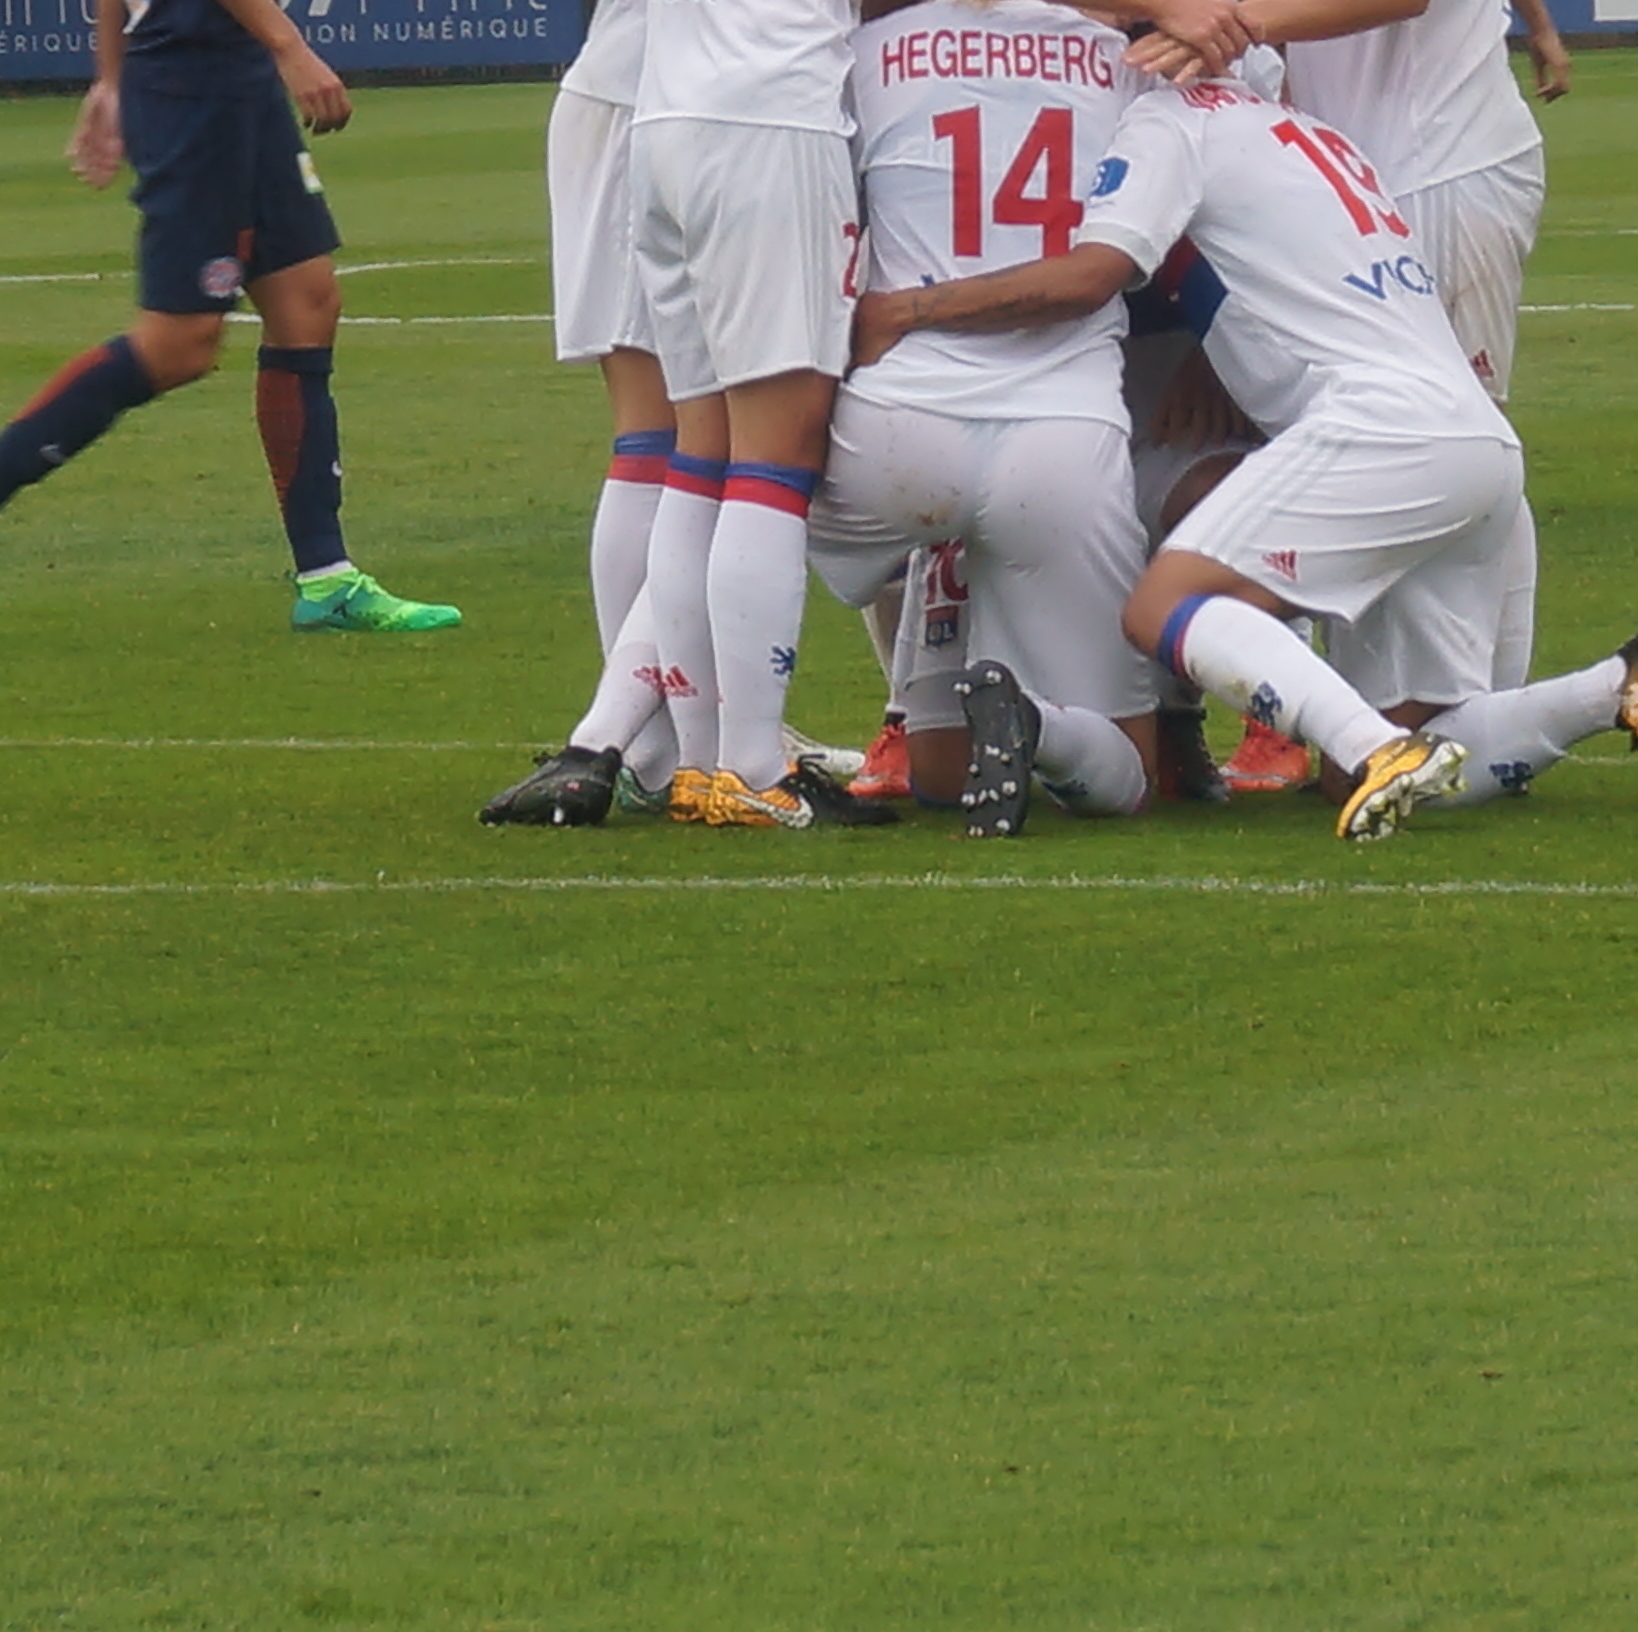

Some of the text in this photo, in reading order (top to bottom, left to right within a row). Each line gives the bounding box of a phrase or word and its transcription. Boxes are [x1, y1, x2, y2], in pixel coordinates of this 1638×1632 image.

[373, 16, 548, 41] NUMÉRIQUE
[881, 29, 1114, 90] HEGERBERG
[932, 104, 1085, 260] 14
